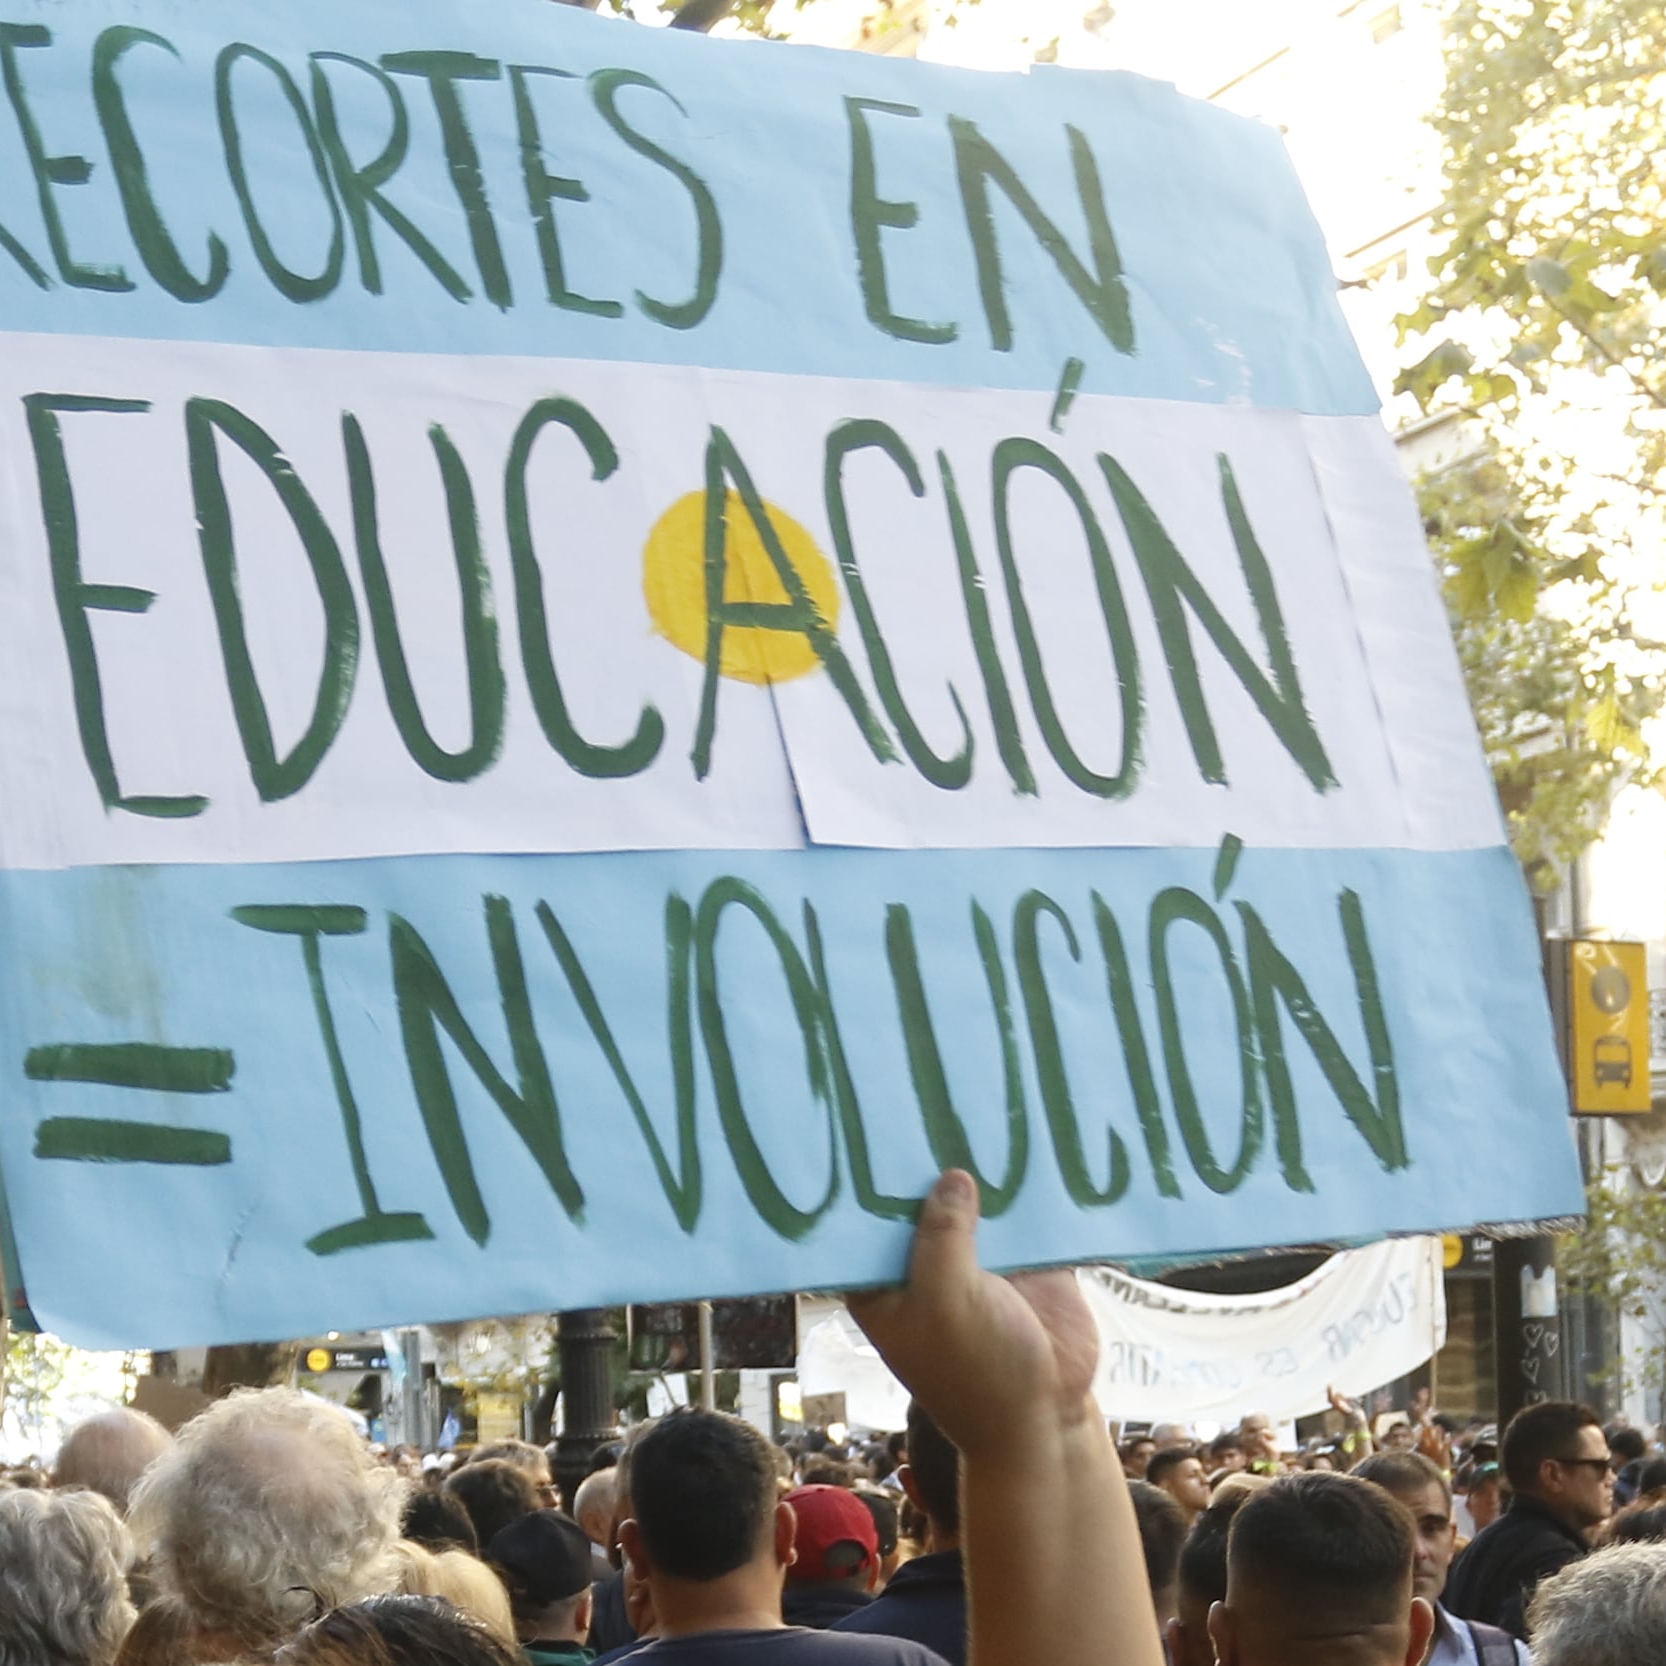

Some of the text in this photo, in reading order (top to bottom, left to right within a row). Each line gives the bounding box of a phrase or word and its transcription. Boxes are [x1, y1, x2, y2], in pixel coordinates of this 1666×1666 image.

[842, 95, 1137, 356] EN
[23, 356, 1340, 820] EDUCACIÓN
[230, 833, 1410, 1257] INVOLUCIÓN
